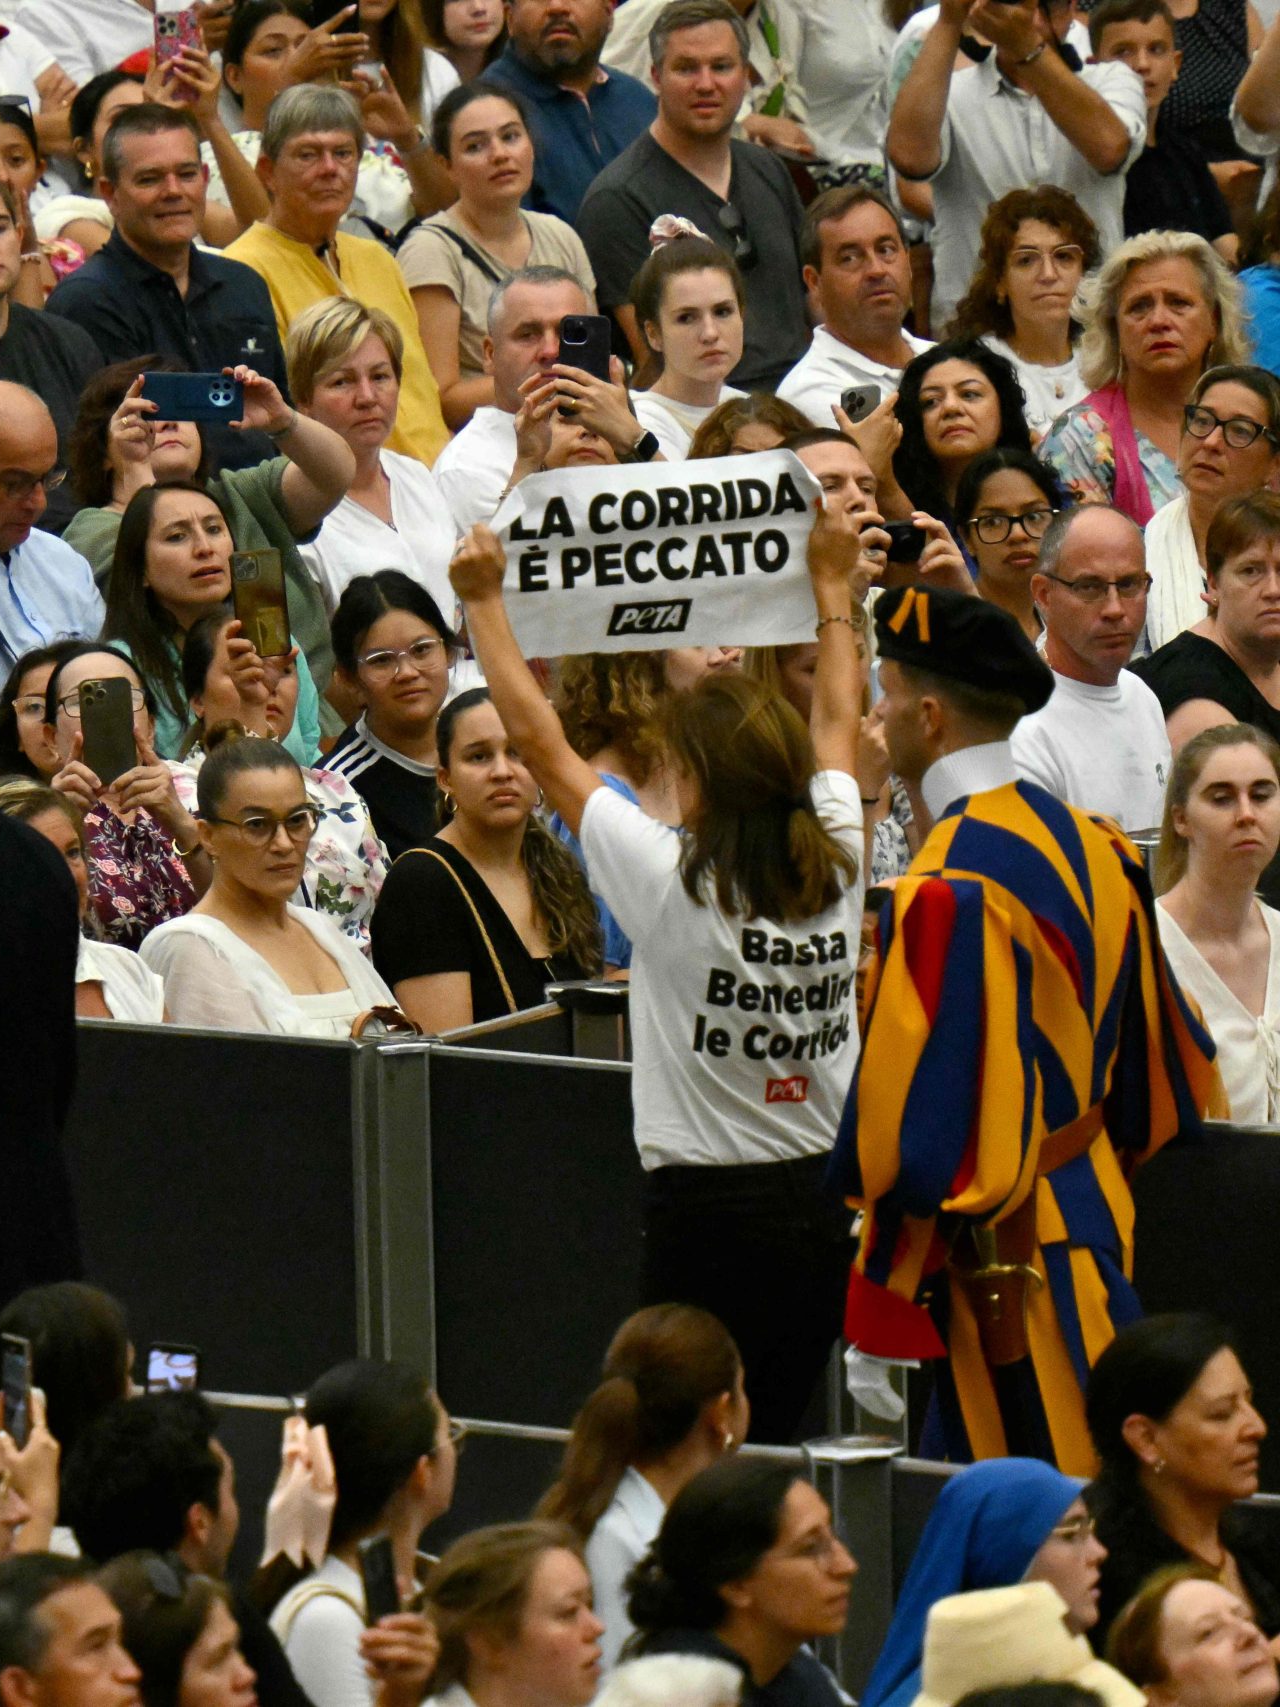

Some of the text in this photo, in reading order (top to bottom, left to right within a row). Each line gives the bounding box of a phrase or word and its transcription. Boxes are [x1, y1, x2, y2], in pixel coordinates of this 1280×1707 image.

[509, 471, 808, 542] LA CORRIDA
[518, 528, 791, 593] È PECCATO
[740, 927, 848, 967] Basta
[706, 966, 855, 1015] Benedir
[692, 1013, 732, 1058] le
